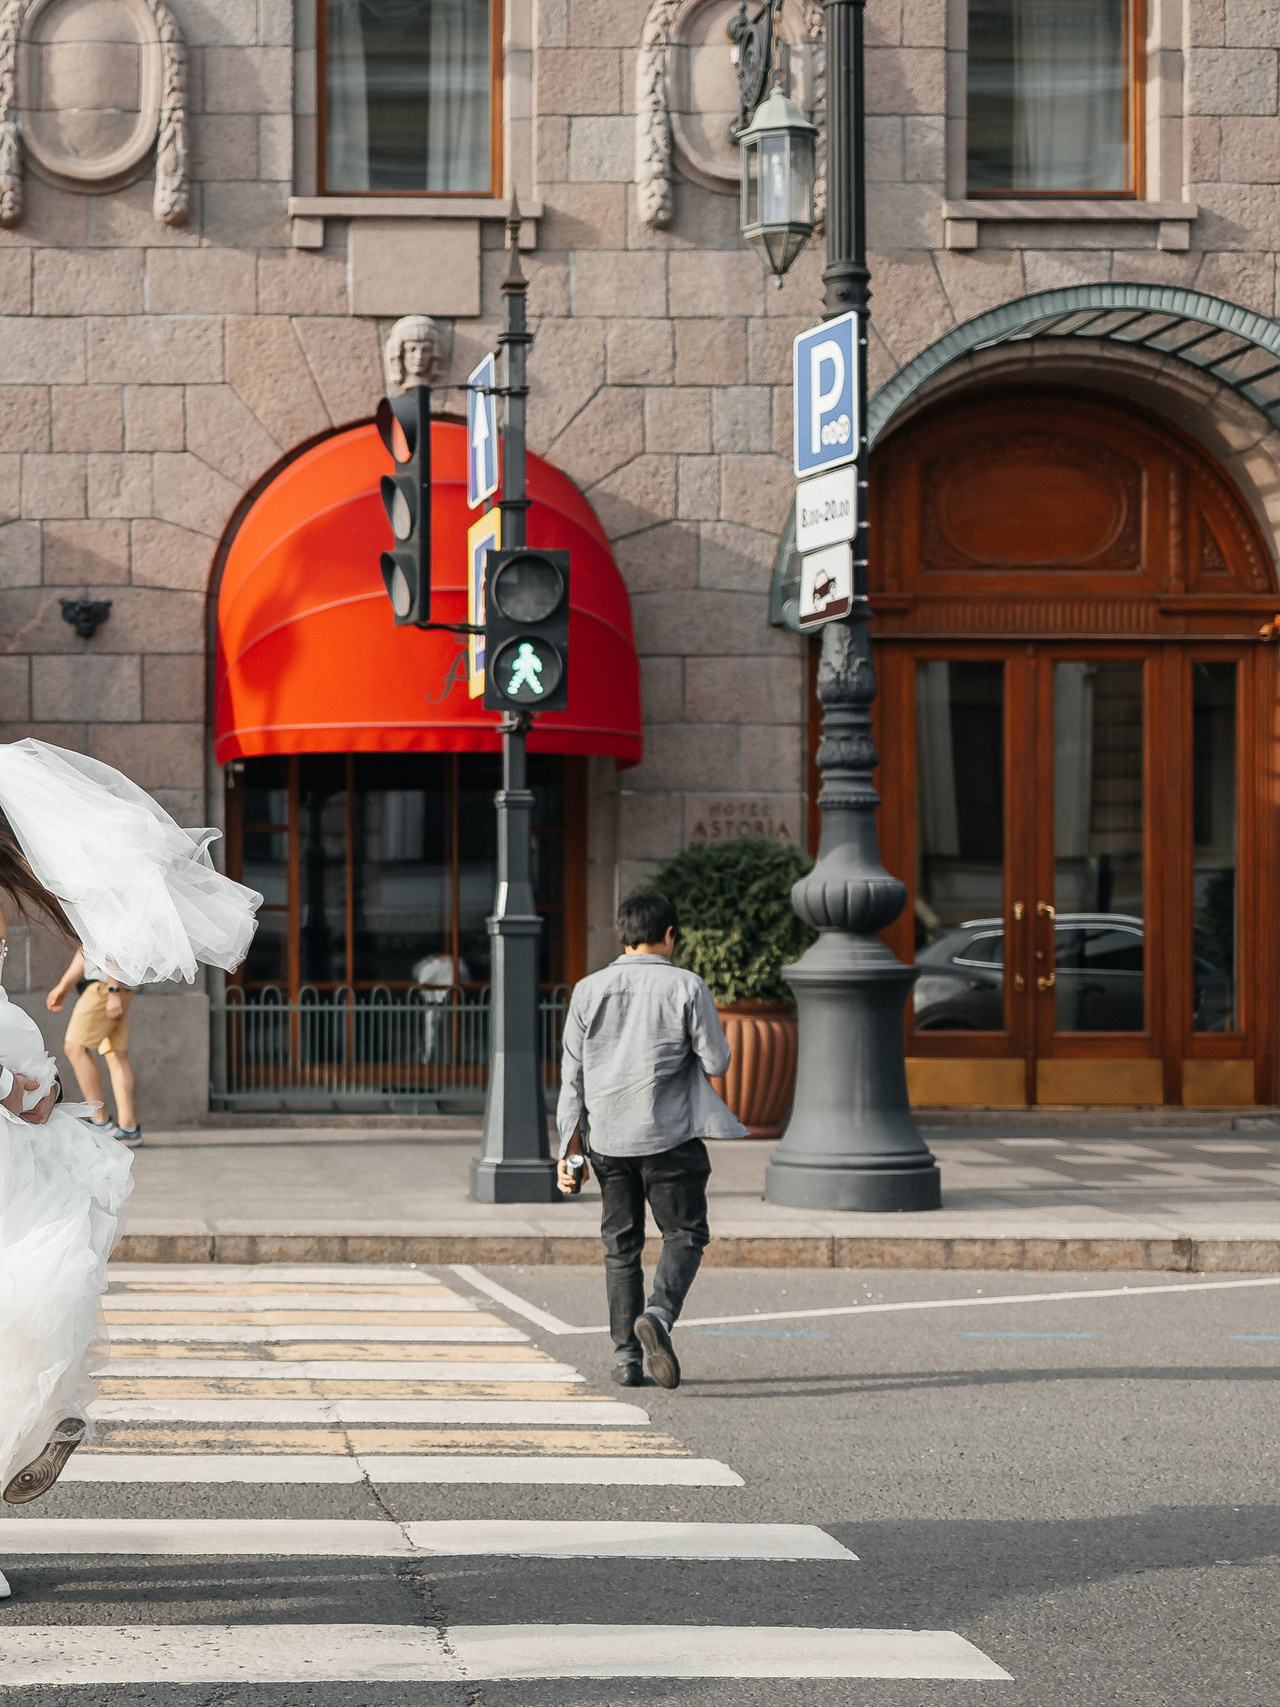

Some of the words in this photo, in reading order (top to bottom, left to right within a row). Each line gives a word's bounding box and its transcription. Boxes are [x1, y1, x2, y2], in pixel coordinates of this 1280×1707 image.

[810, 339, 845, 454] P
[709, 802, 772, 817] HOTEL
[692, 819, 791, 838] ASTORIA
